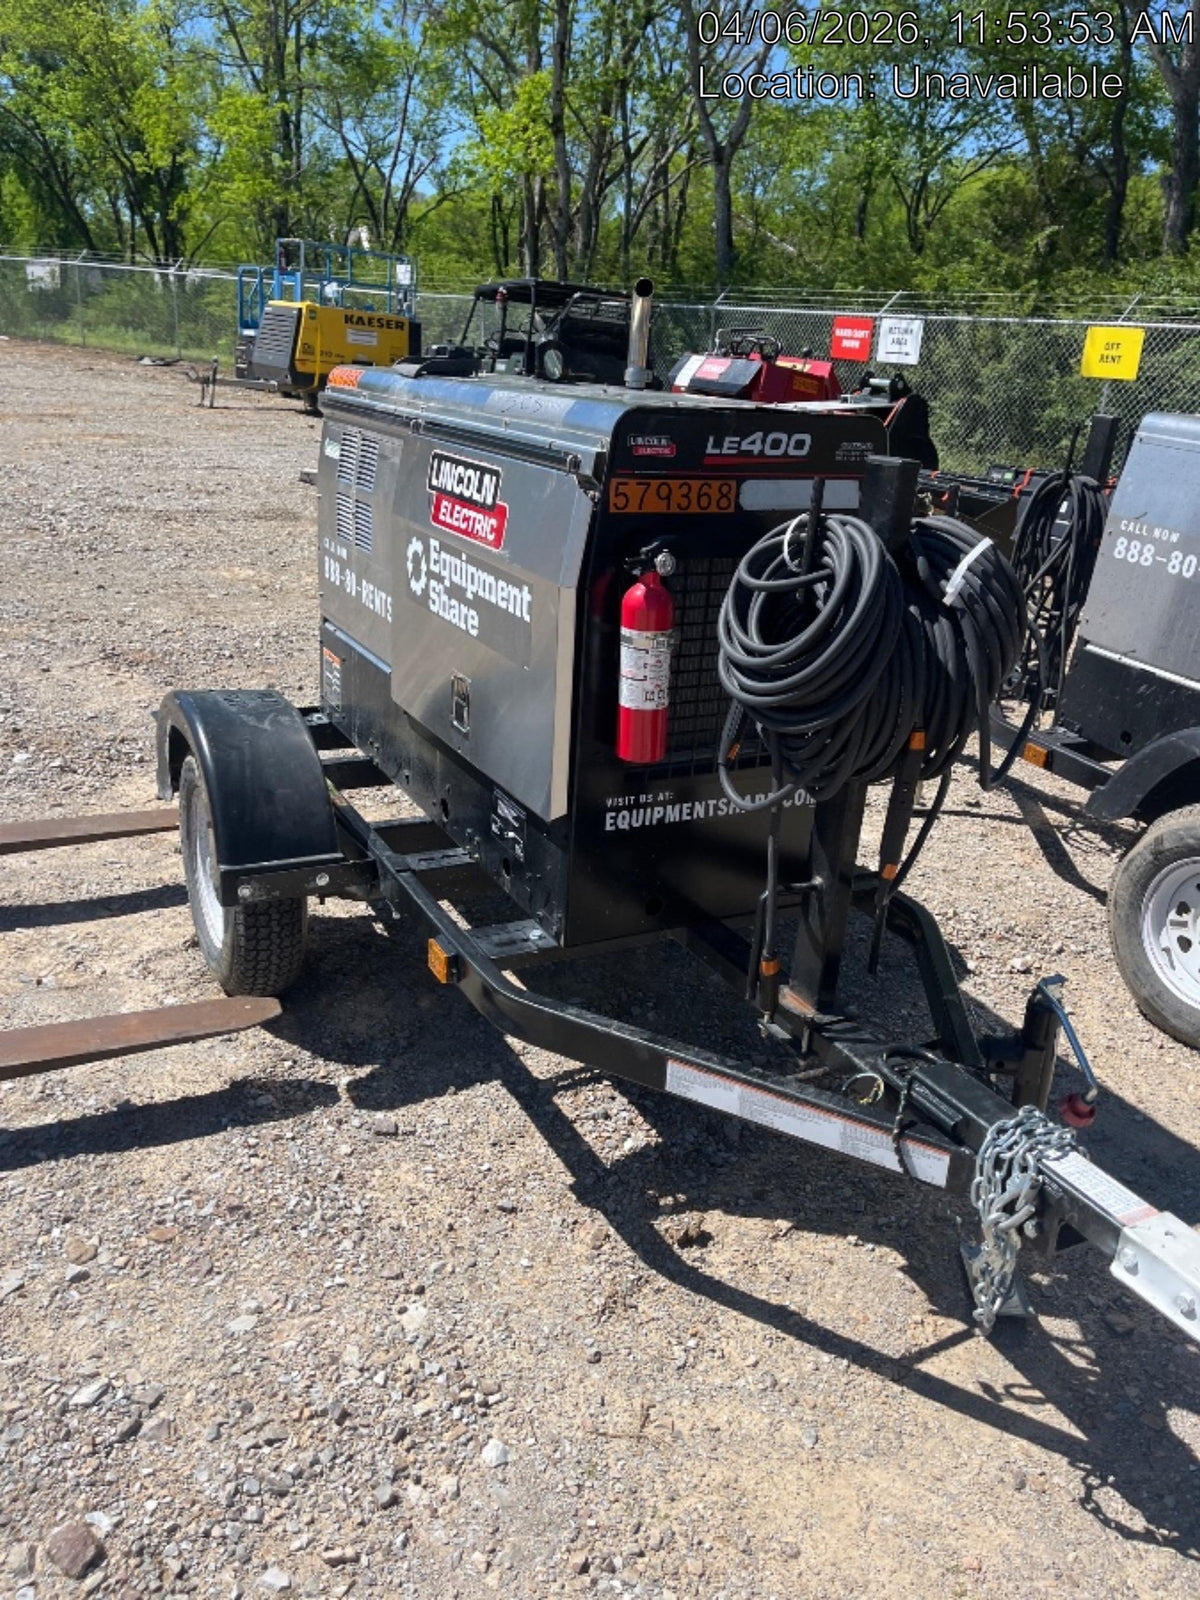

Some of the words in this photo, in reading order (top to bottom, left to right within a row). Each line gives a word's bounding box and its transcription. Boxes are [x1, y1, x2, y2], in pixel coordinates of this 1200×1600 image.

[344, 314, 405, 331] KAESER
[1098, 353, 1122, 364] RENT
[1104, 341, 1122, 351] OFF
[705, 432, 812, 456] LE400
[431, 458, 497, 506] LINCOLN
[613, 482, 734, 511] 579368
[439, 500, 497, 541] ELECTRIC
[1121, 520, 1148, 536] CALL
[1153, 528, 1180, 543] NOW
[1114, 536, 1200, 578] 888-80
[429, 538, 532, 623] Equipment
[429, 579, 480, 637] Share
[606, 795, 635, 808] VISIT
[640, 794, 654, 804] US
